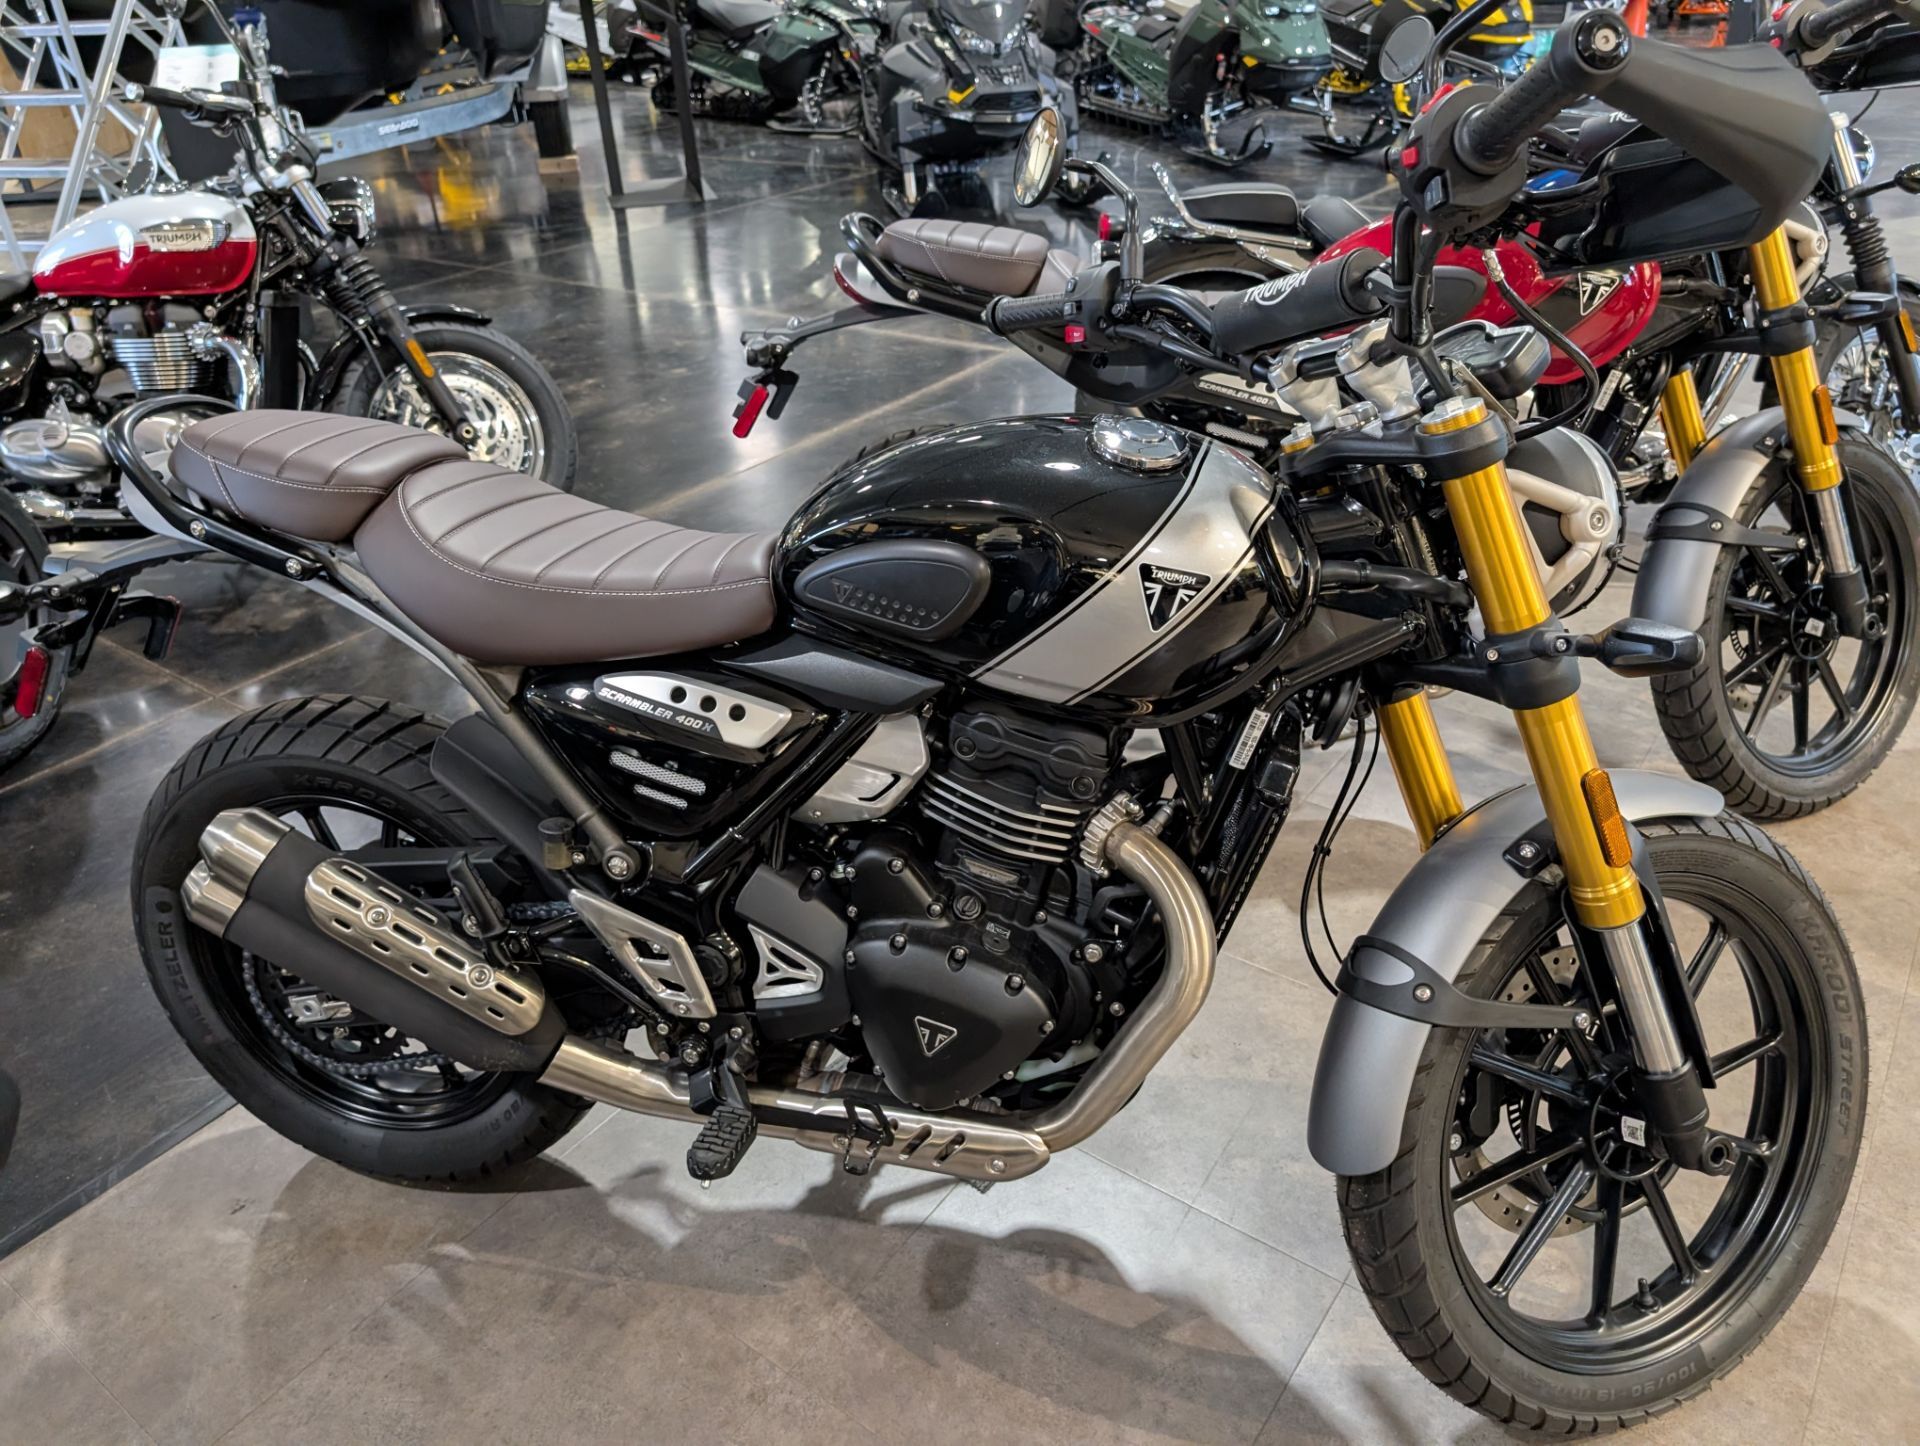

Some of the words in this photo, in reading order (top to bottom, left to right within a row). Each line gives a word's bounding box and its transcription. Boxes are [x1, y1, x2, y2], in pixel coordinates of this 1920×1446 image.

[149, 232, 202, 244] TRIUMPH
[1243, 268, 1313, 306] TRIUMPH
[1198, 381, 1249, 400] SCRAMBLER
[1151, 568, 1197, 586] TRIUMPH
[598, 686, 674, 720] SCRAMBLER
[1838, 1032, 1856, 1135] STREET
[1630, 1361, 1698, 1398] 100/90
